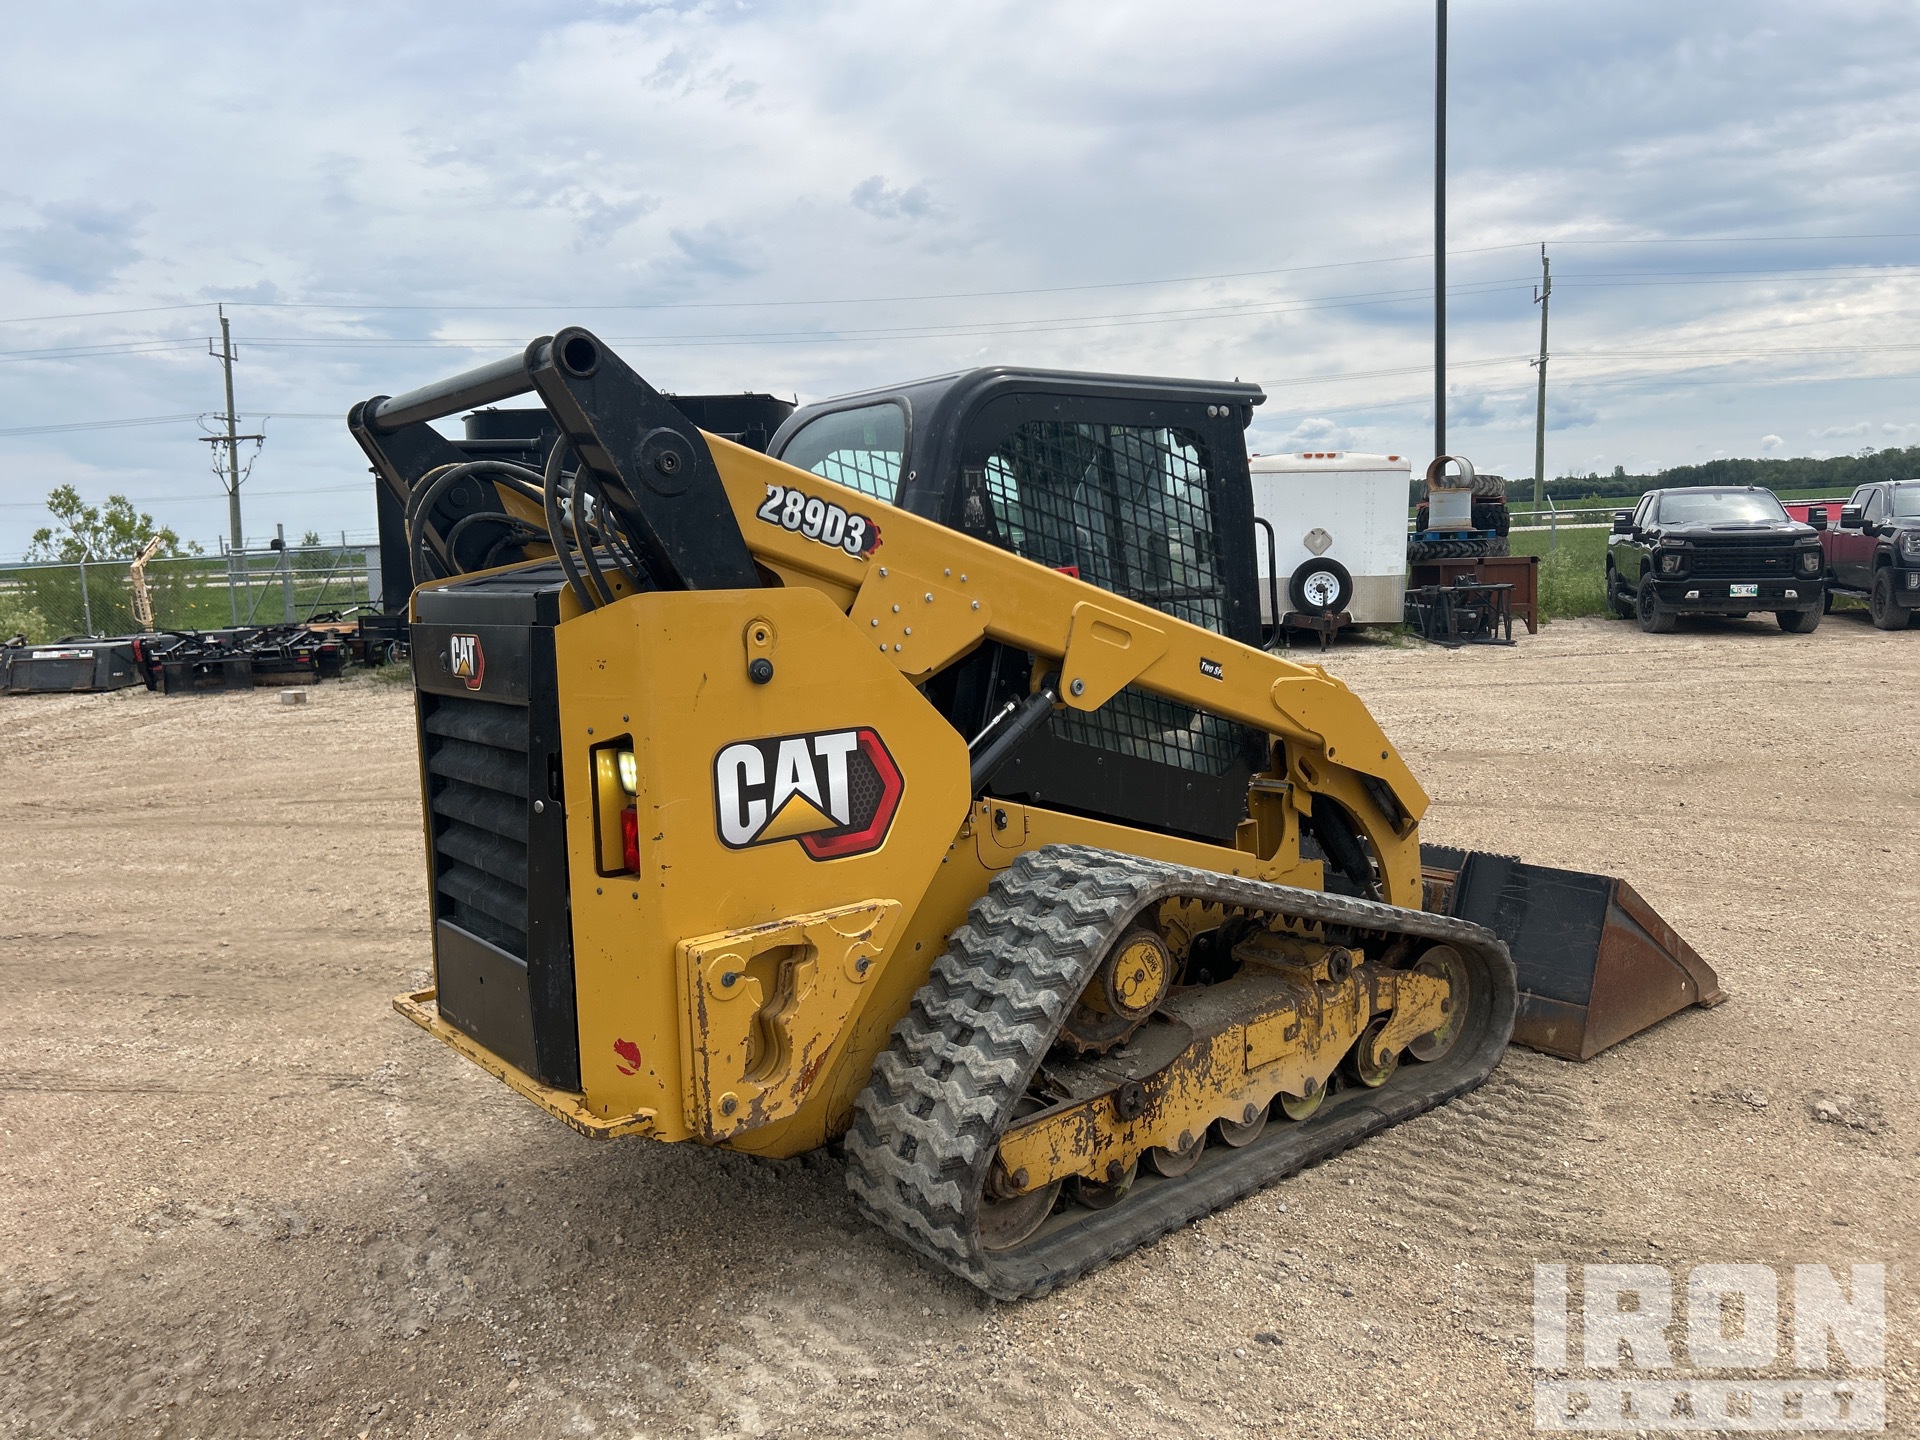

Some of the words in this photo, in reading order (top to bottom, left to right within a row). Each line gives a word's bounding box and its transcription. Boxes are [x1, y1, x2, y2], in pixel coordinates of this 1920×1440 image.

[758, 485, 866, 553] 289D3
[451, 636, 475, 676] CAT
[717, 731, 858, 845] CAT
